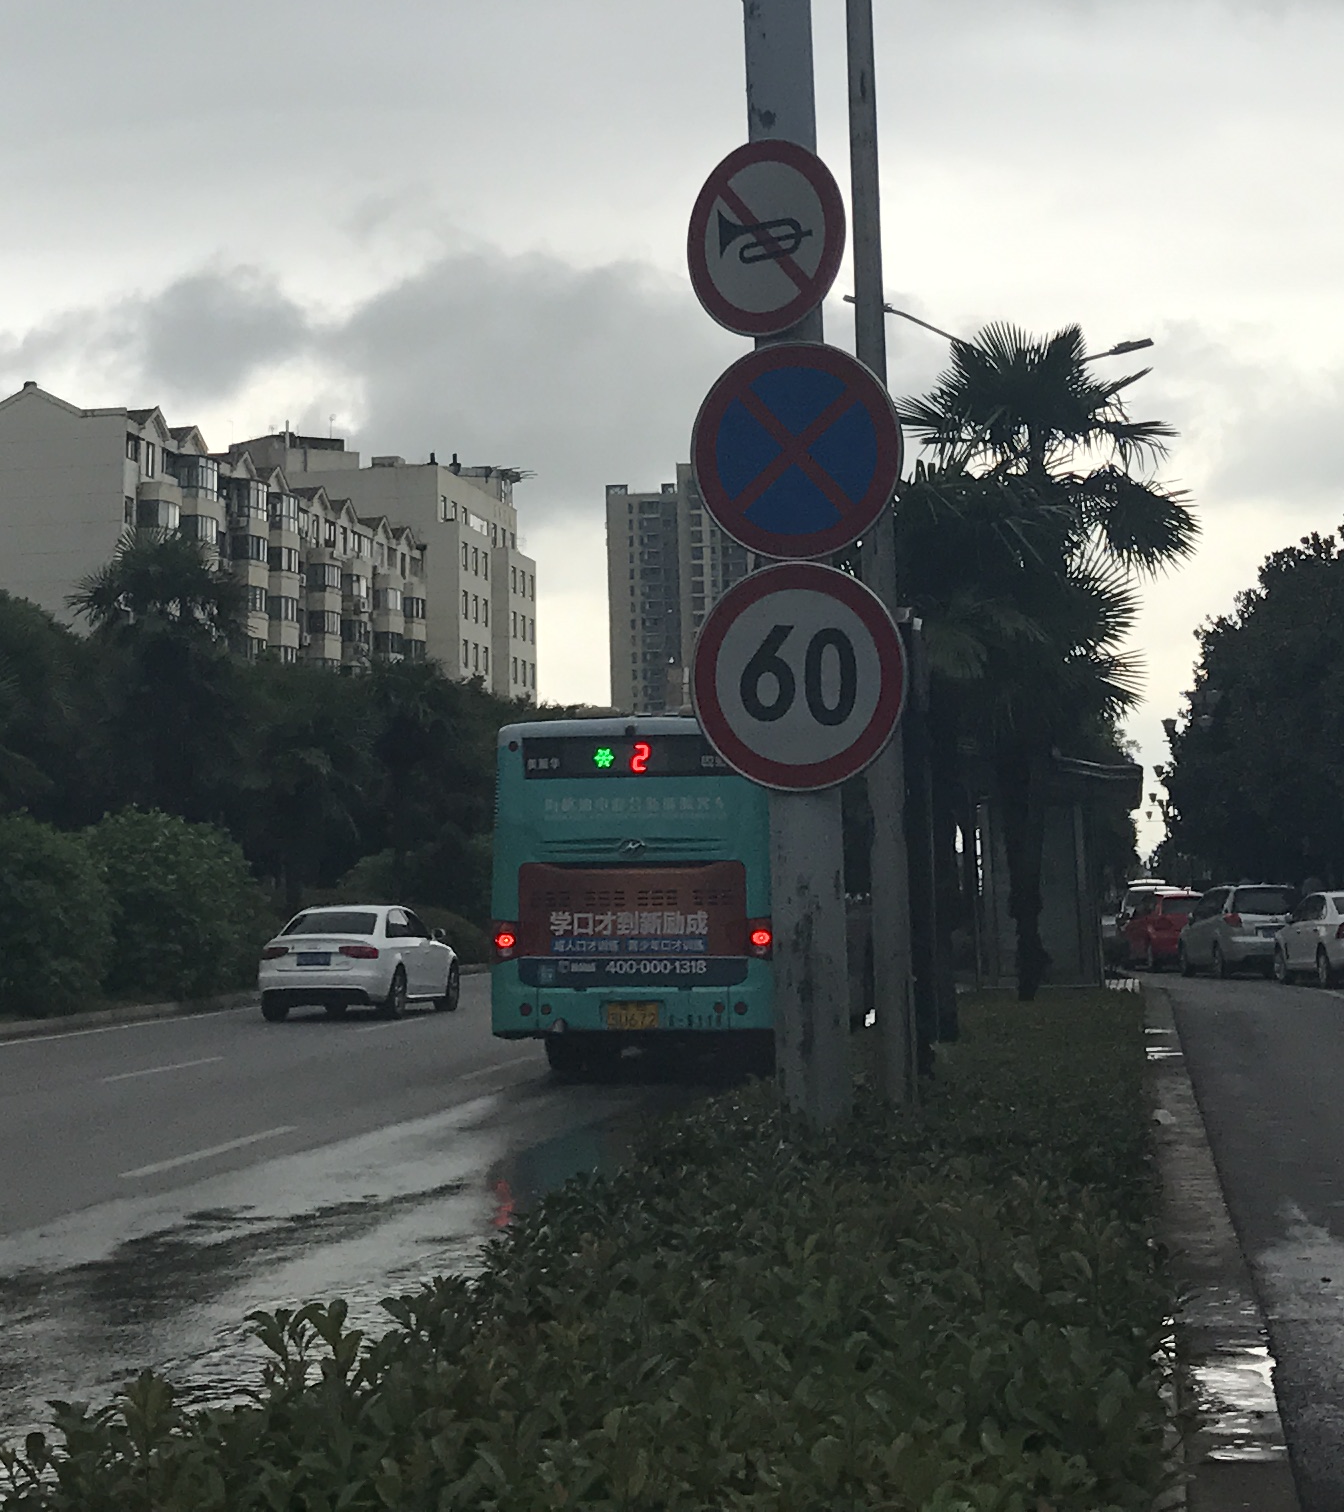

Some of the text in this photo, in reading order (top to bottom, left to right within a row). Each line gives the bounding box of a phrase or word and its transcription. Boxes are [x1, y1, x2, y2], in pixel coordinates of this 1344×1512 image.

[739, 624, 857, 726] 60
[630, 741, 652, 775] 2
[549, 910, 709, 936] 学口才到新励成
[605, 960, 707, 975] 400-000-1318
